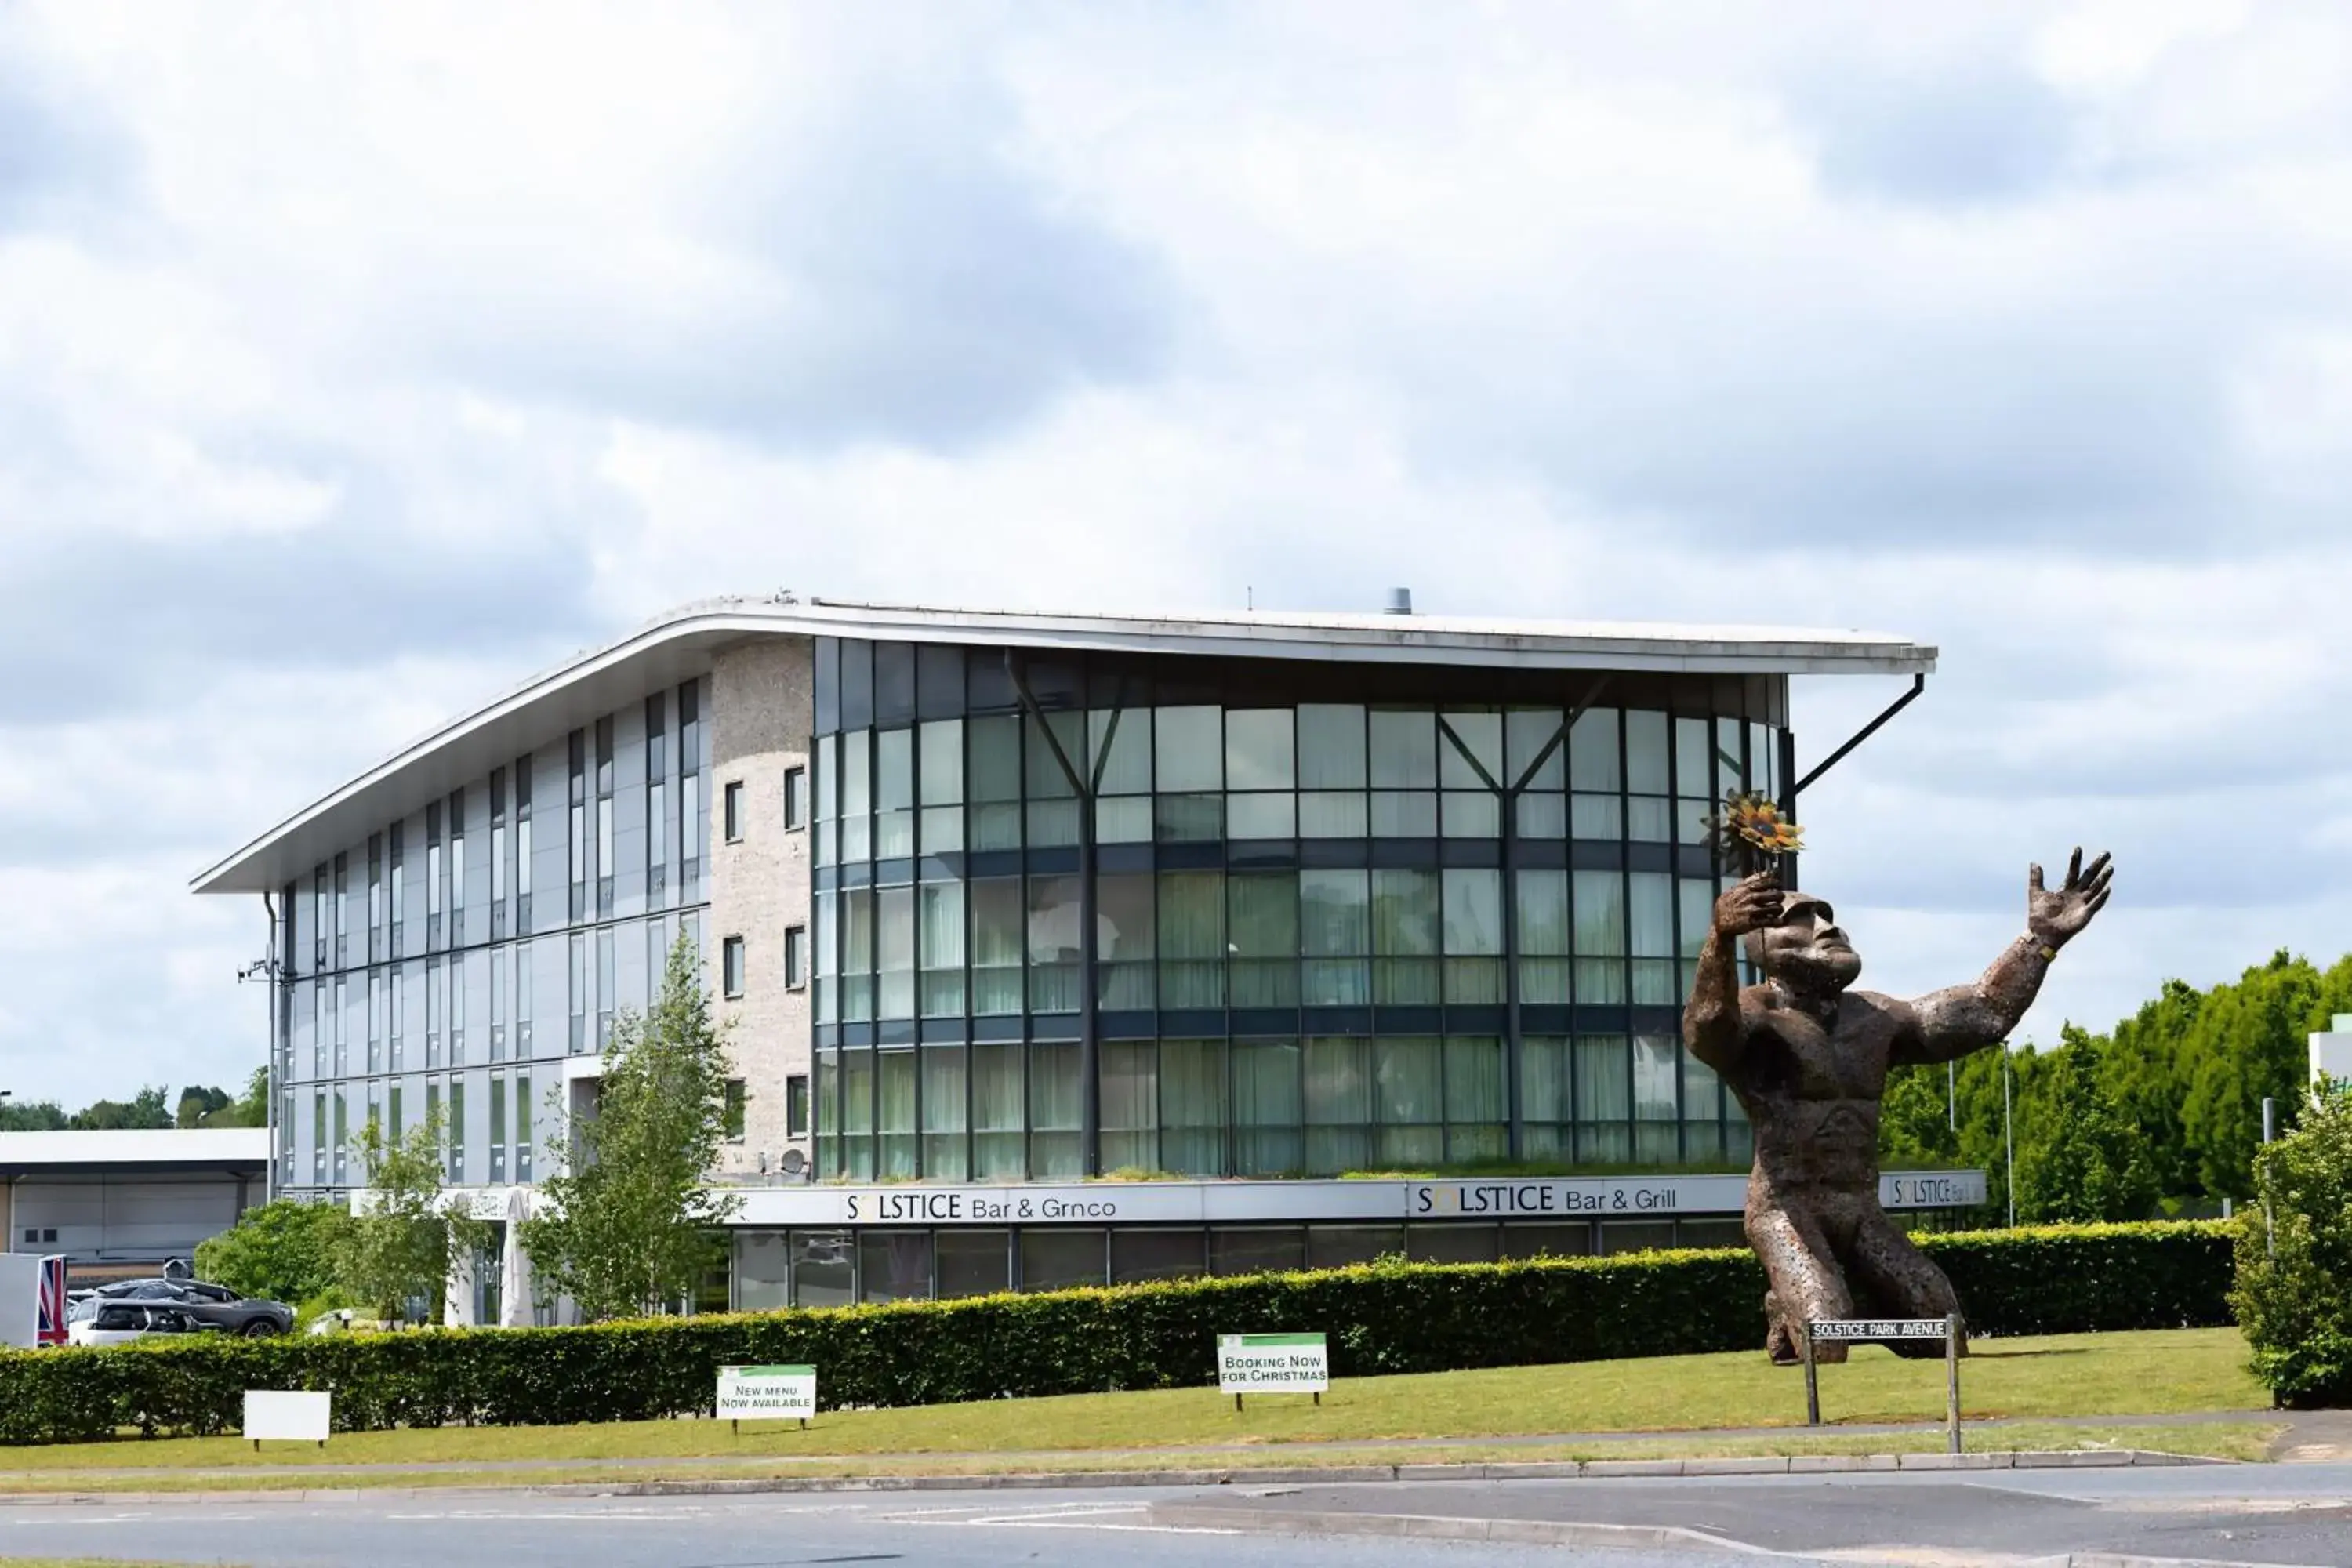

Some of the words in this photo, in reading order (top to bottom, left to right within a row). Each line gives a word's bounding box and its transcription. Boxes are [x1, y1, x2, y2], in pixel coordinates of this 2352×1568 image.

[1418, 1186, 1554, 1212] SOLSTICE
[1566, 1191, 1606, 1210] Bar
[1613, 1189, 1628, 1210] &
[1635, 1189, 1676, 1210] Grill
[848, 1194, 961, 1219] SLSTICE
[972, 1199, 1011, 1218] Bar
[1018, 1198, 1034, 1218] &
[1813, 1324, 1865, 1336] SOLSTICE
[1870, 1324, 1897, 1335] PARK
[1902, 1323, 1944, 1335] AVENUE
[1222, 1373, 1247, 1382] FOR
[765, 1387, 797, 1396] MENU
[753, 1399, 810, 1407] AVAILABLE
